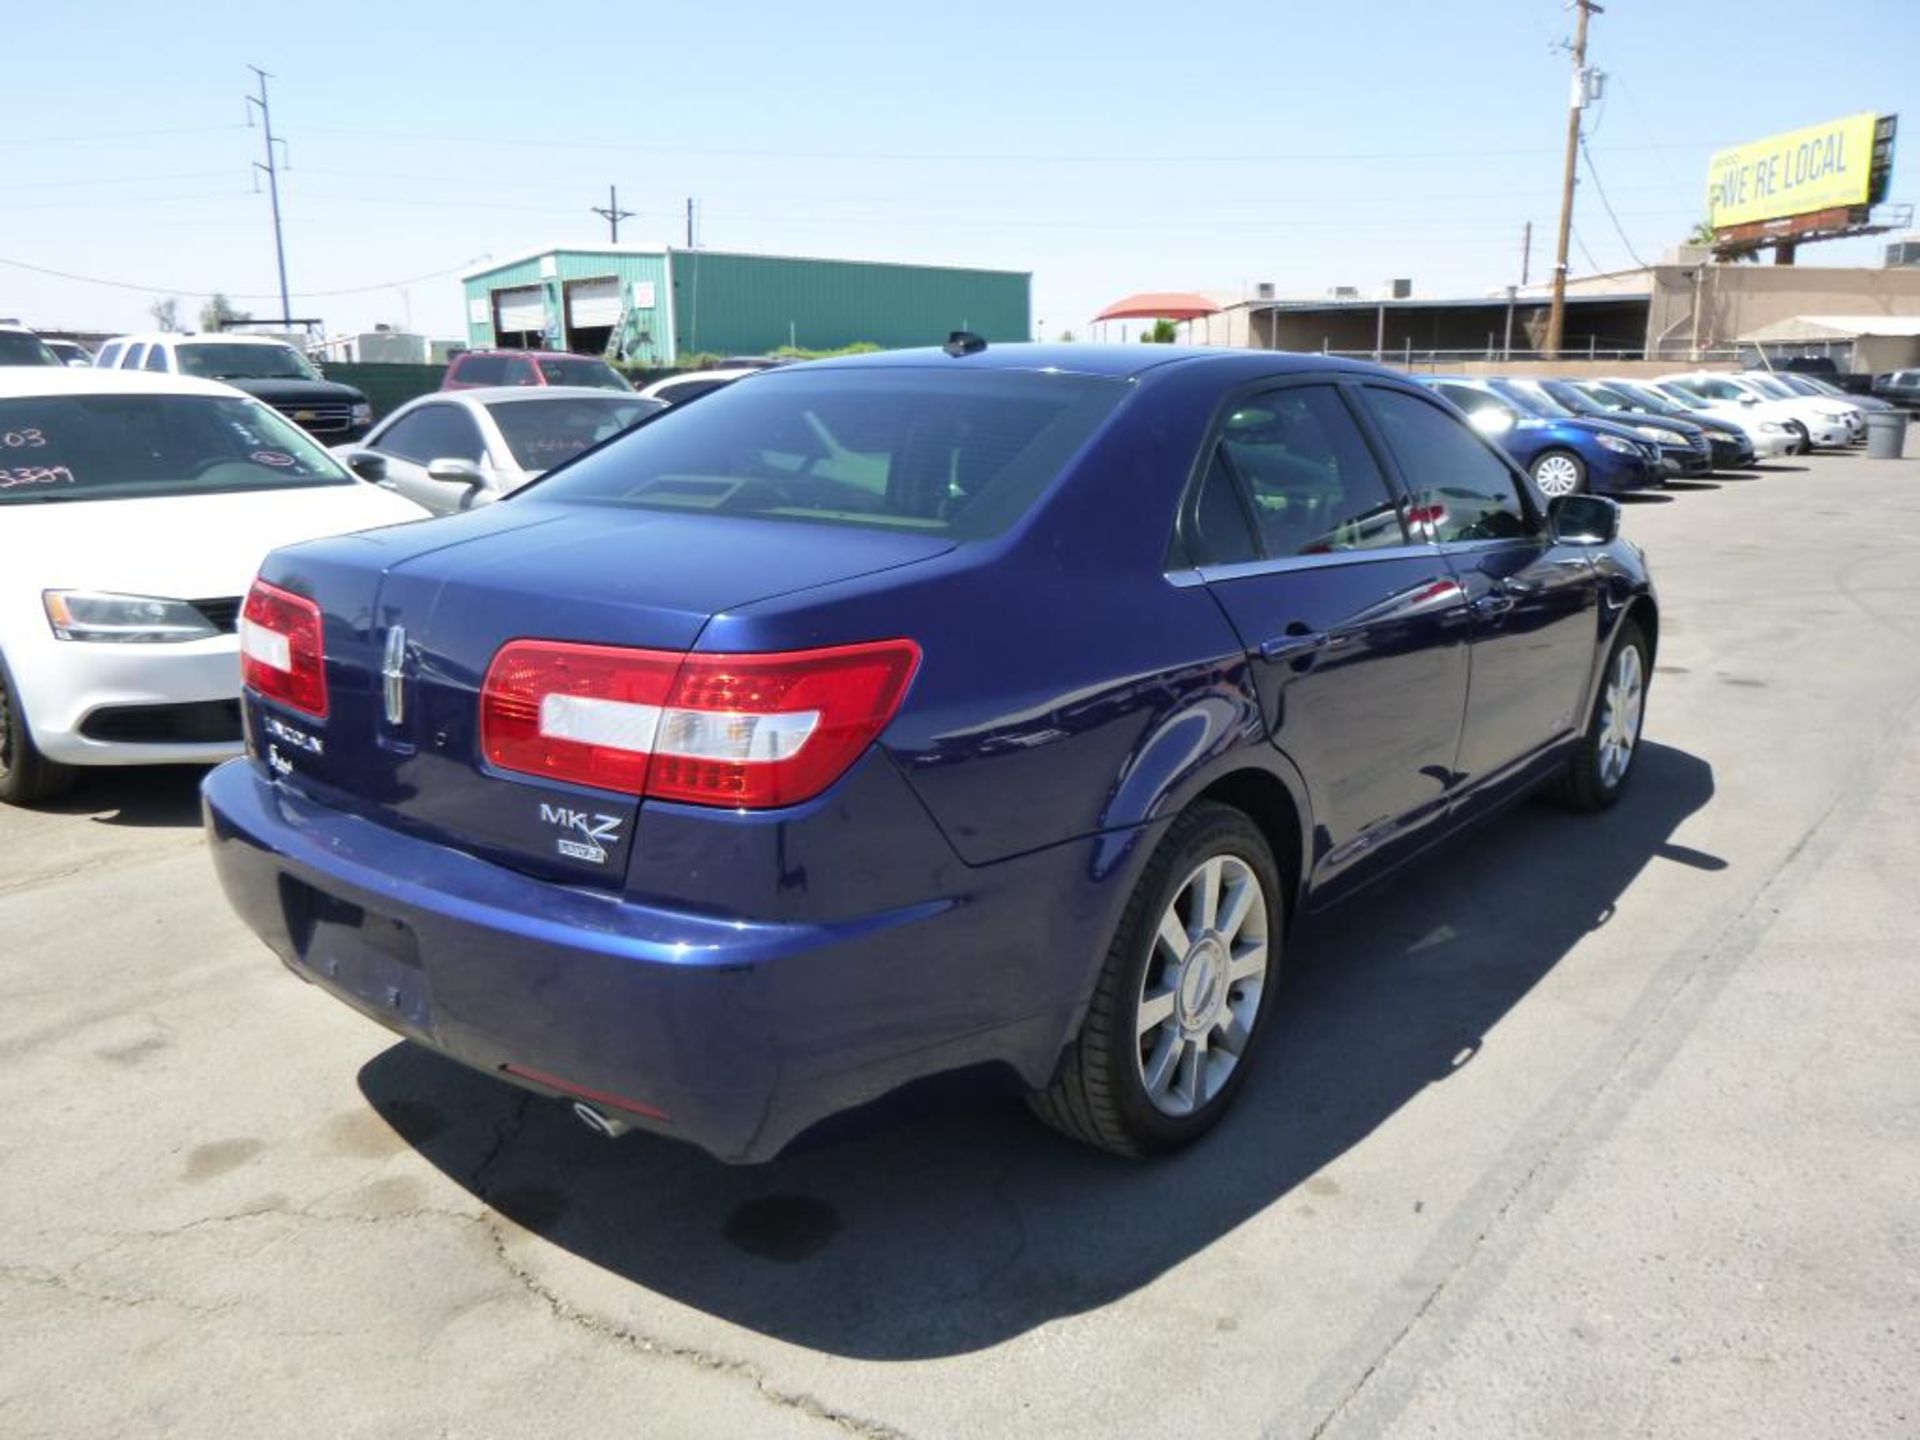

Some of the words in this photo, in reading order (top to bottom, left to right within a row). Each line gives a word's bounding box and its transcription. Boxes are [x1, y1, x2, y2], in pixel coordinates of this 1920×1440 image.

[1722, 154, 1779, 208] WE'RE
[1784, 131, 1846, 189] LOCAL
[540, 802, 623, 842] MKZ
